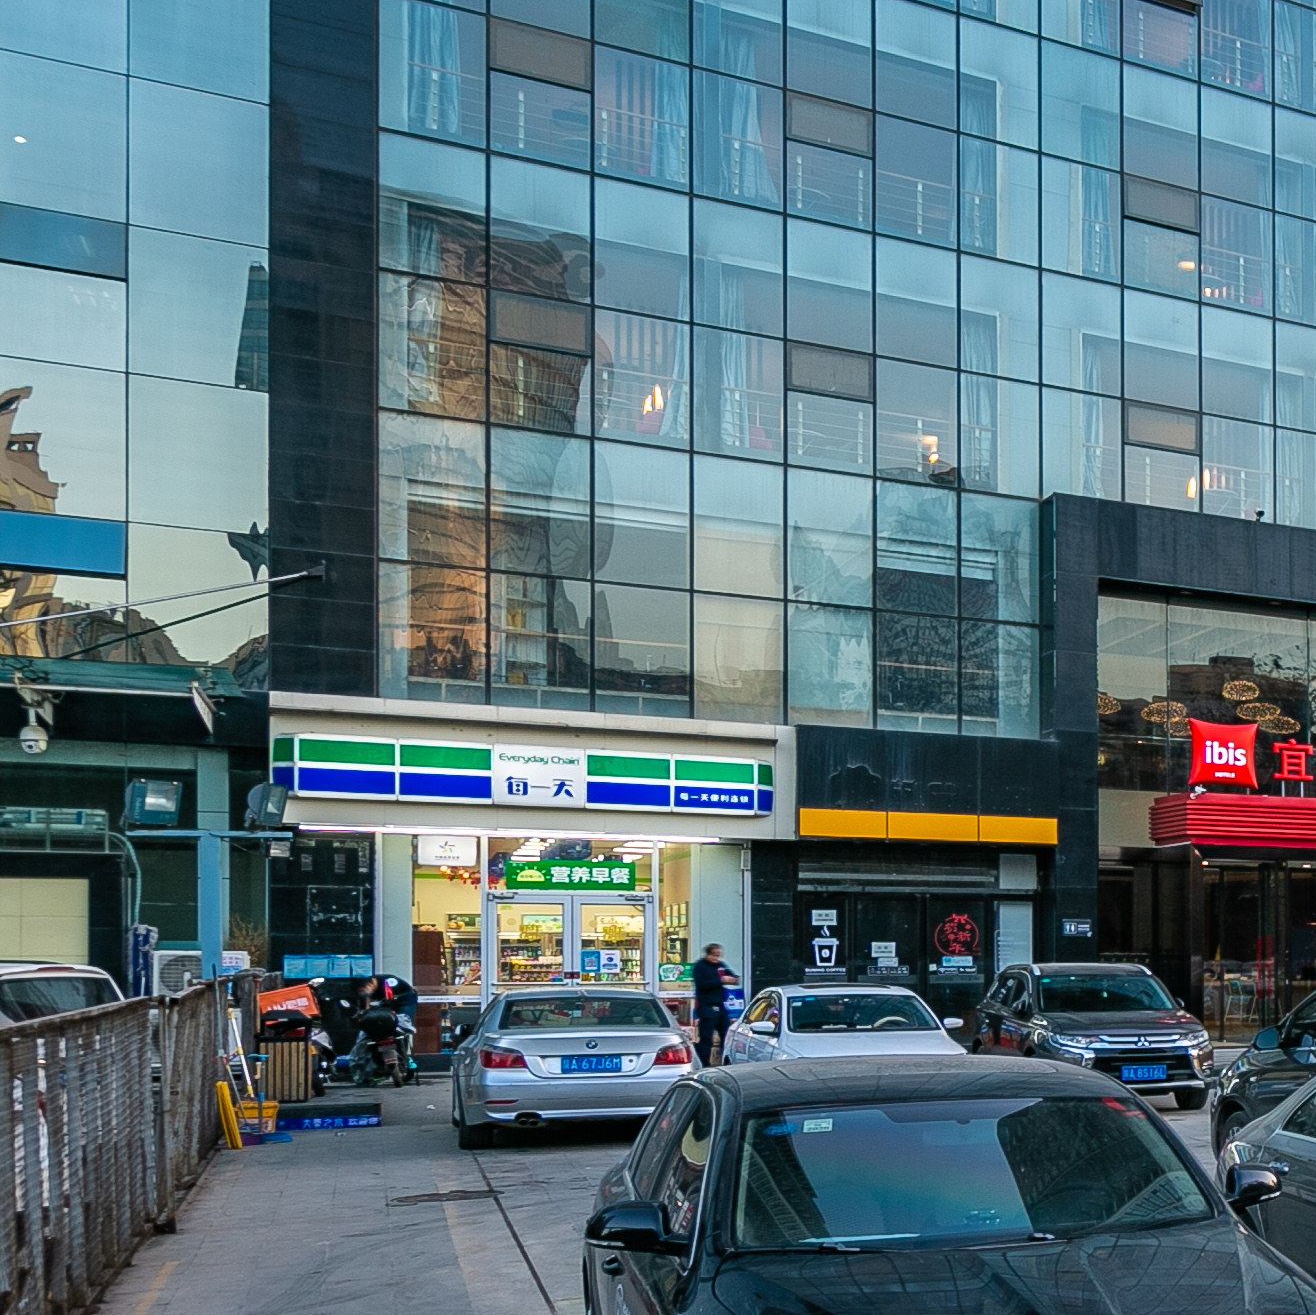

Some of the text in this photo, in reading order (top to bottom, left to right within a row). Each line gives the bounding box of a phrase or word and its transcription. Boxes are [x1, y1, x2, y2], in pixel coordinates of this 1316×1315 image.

[498, 753, 580, 766] Everyday Chain
[1204, 740, 1247, 767] ibis
[505, 776, 574, 798] 每一天
[550, 866, 631, 884] 营养早餐
